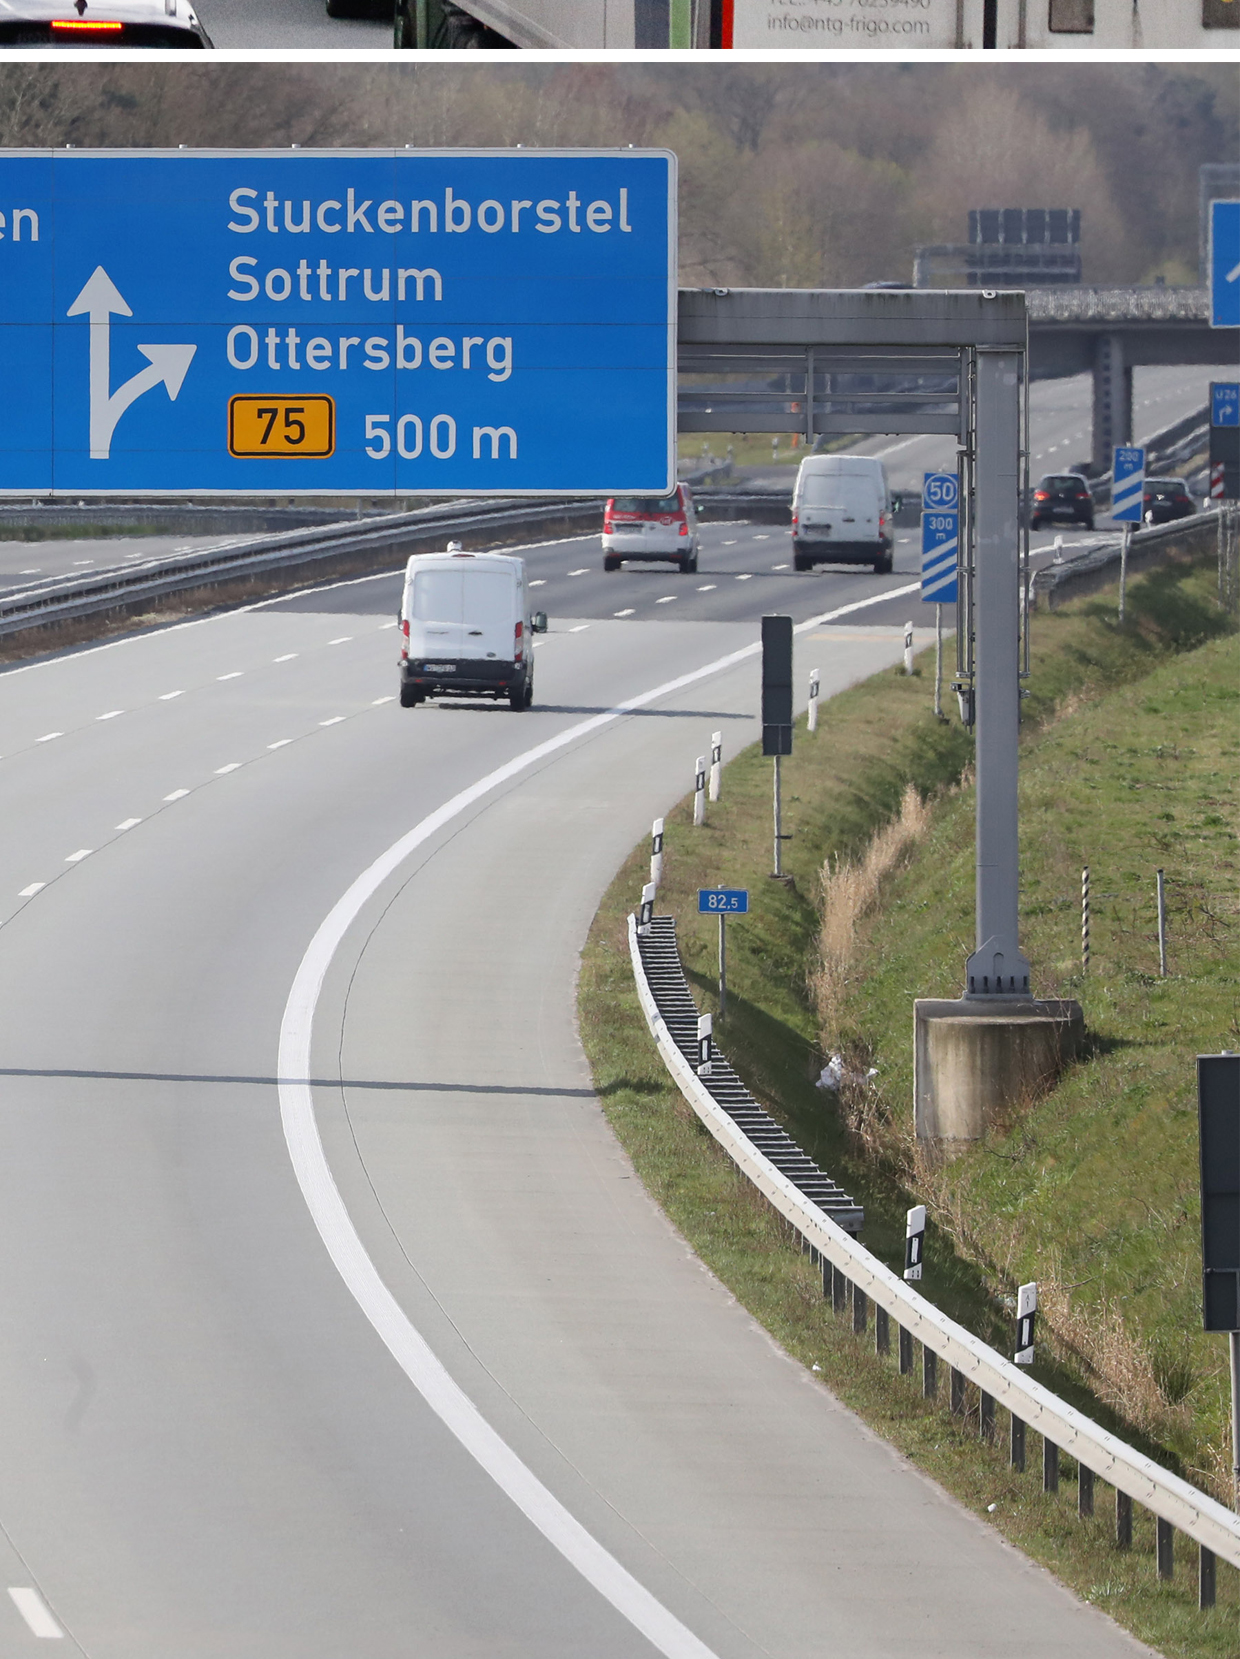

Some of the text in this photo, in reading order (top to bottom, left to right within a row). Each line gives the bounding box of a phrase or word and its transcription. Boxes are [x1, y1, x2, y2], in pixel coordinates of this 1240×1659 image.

[767, 13, 930, 38] info@ntg-frigo.com
[227, 187, 632, 234] Stuckenborstel
[226, 255, 443, 302] Sottrum
[226, 322, 513, 383] Ottersberg
[256, 407, 306, 446] 75
[365, 413, 518, 460] 500 m
[1119, 450, 1139, 462] 200
[929, 481, 954, 501] 50
[929, 516, 953, 531] 300
[935, 531, 947, 540] m
